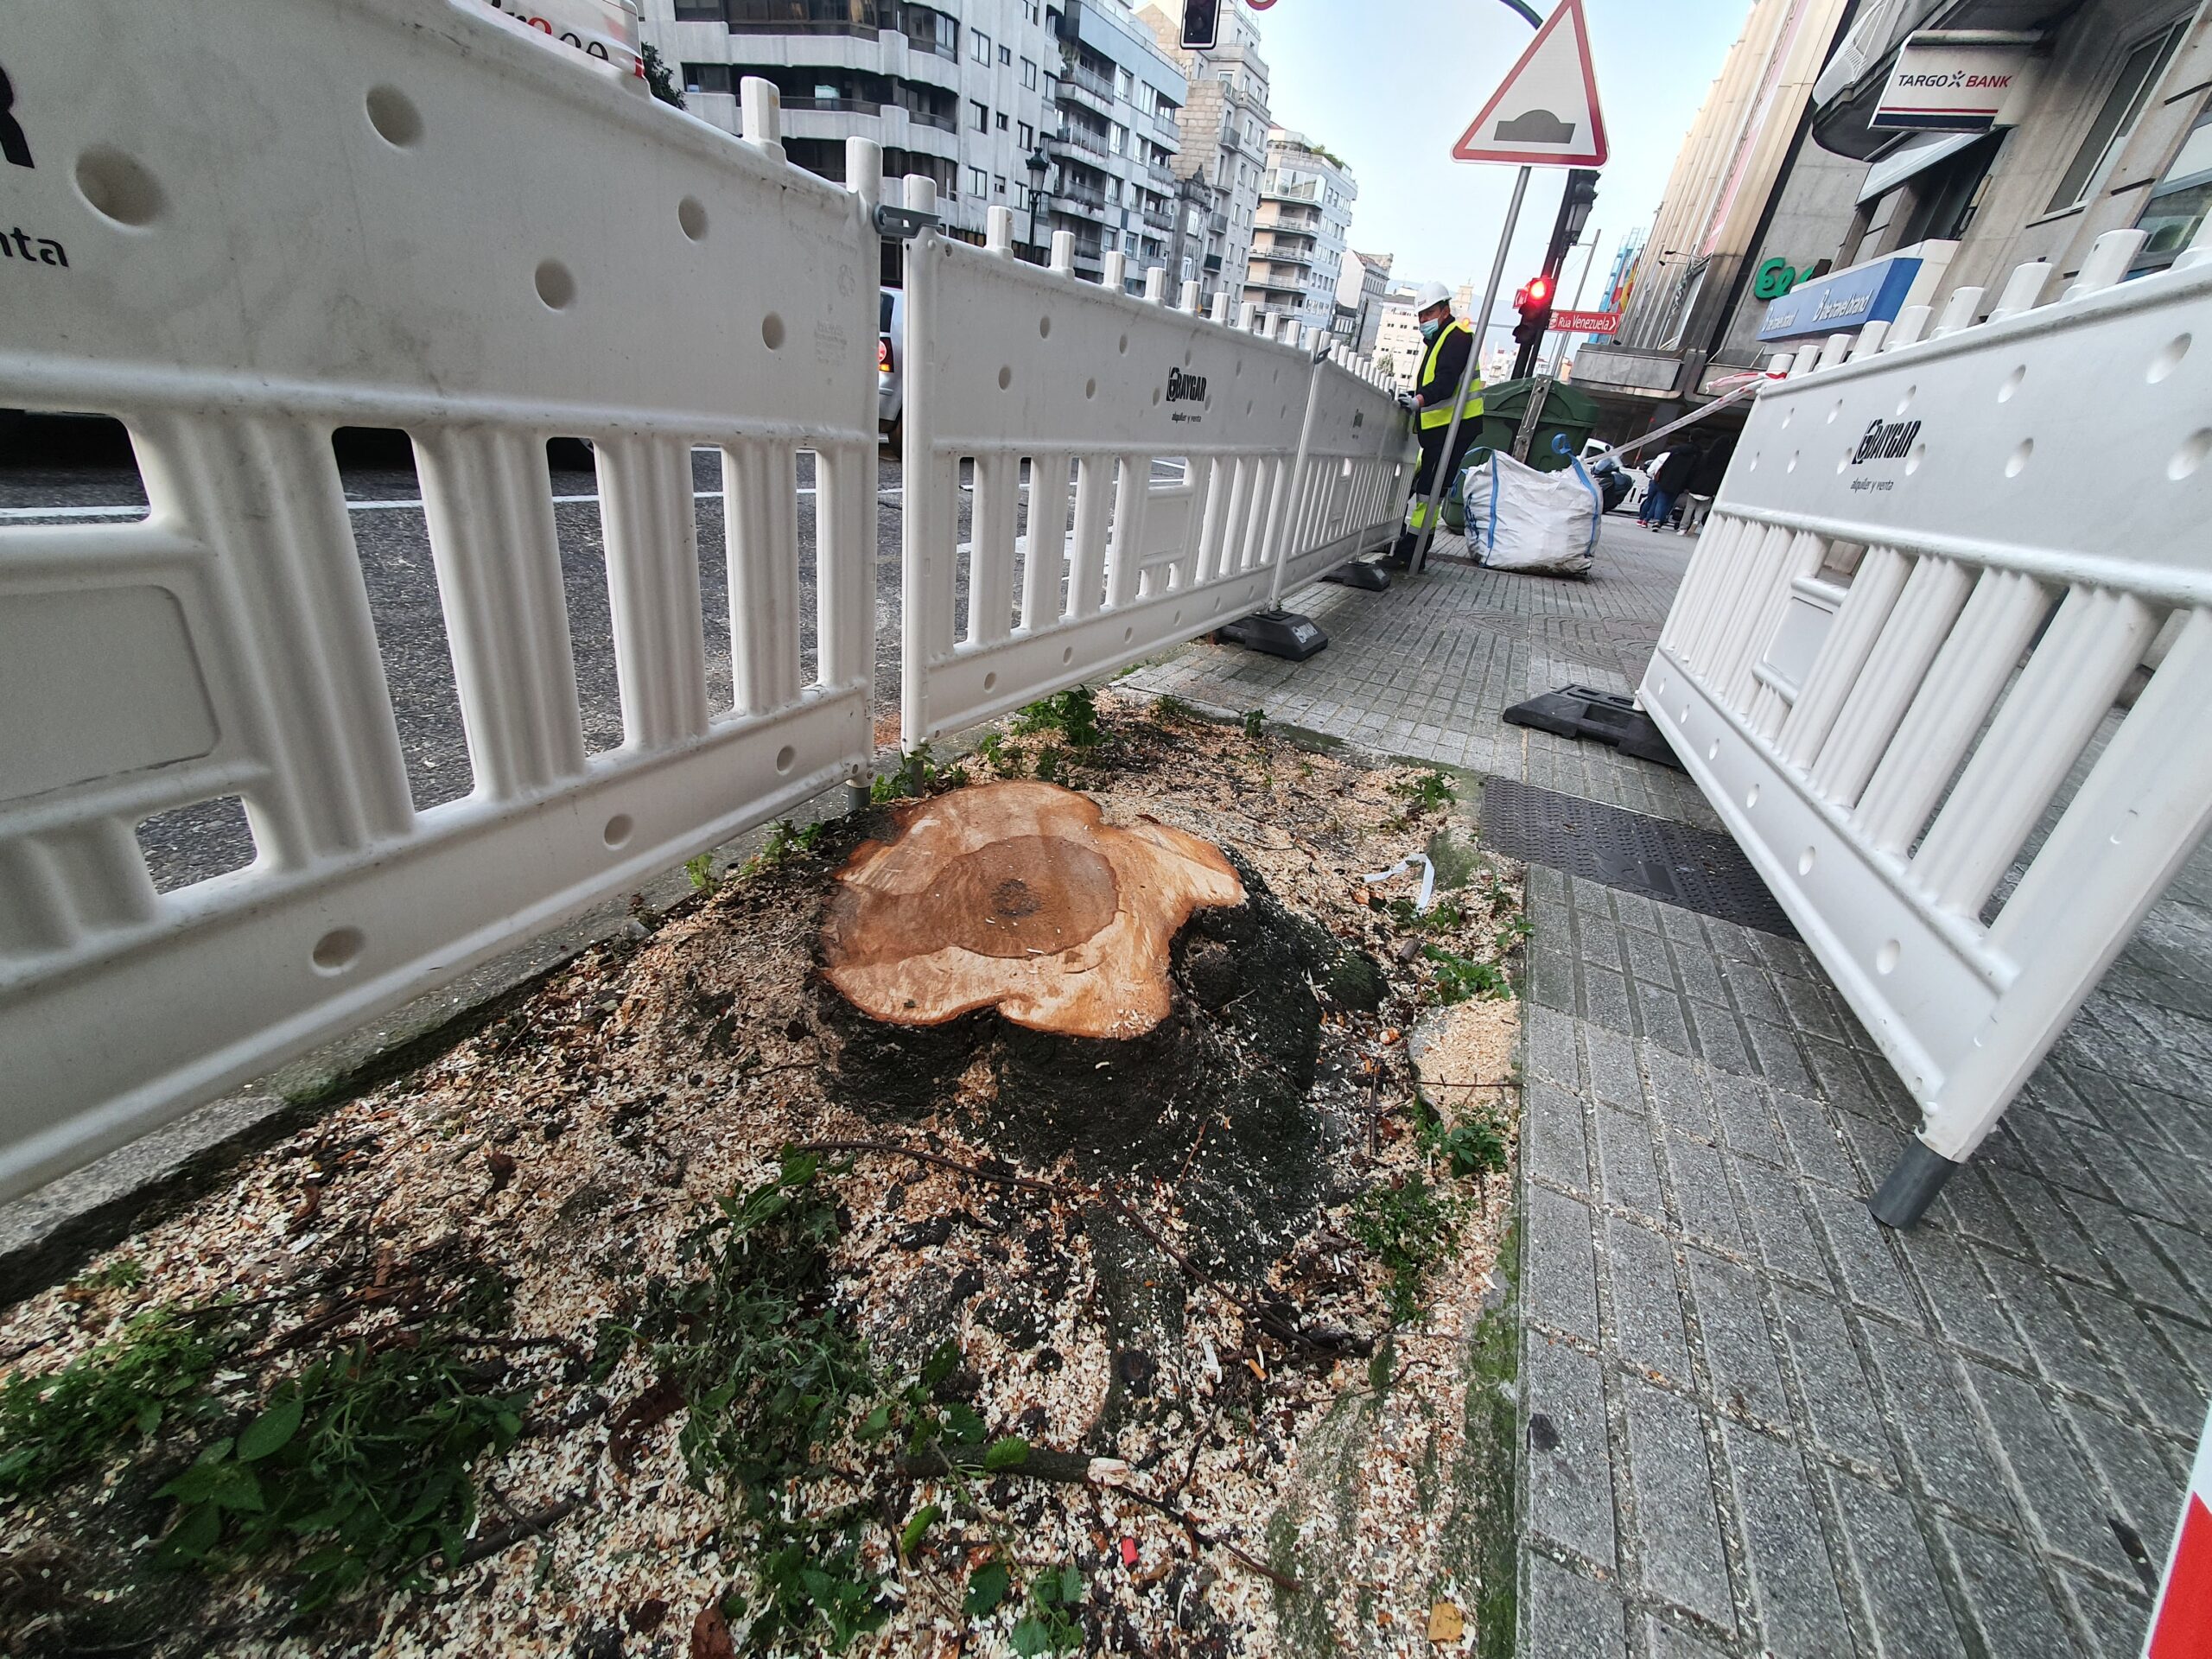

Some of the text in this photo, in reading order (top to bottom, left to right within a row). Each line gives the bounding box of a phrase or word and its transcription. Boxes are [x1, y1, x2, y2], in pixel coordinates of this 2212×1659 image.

[1965, 74, 2012, 87] BANK
[1558, 315, 1610, 330] Rúa Venezuela
[1176, 372, 1207, 402] BAYGAR
[1876, 480, 1894, 491] venta
